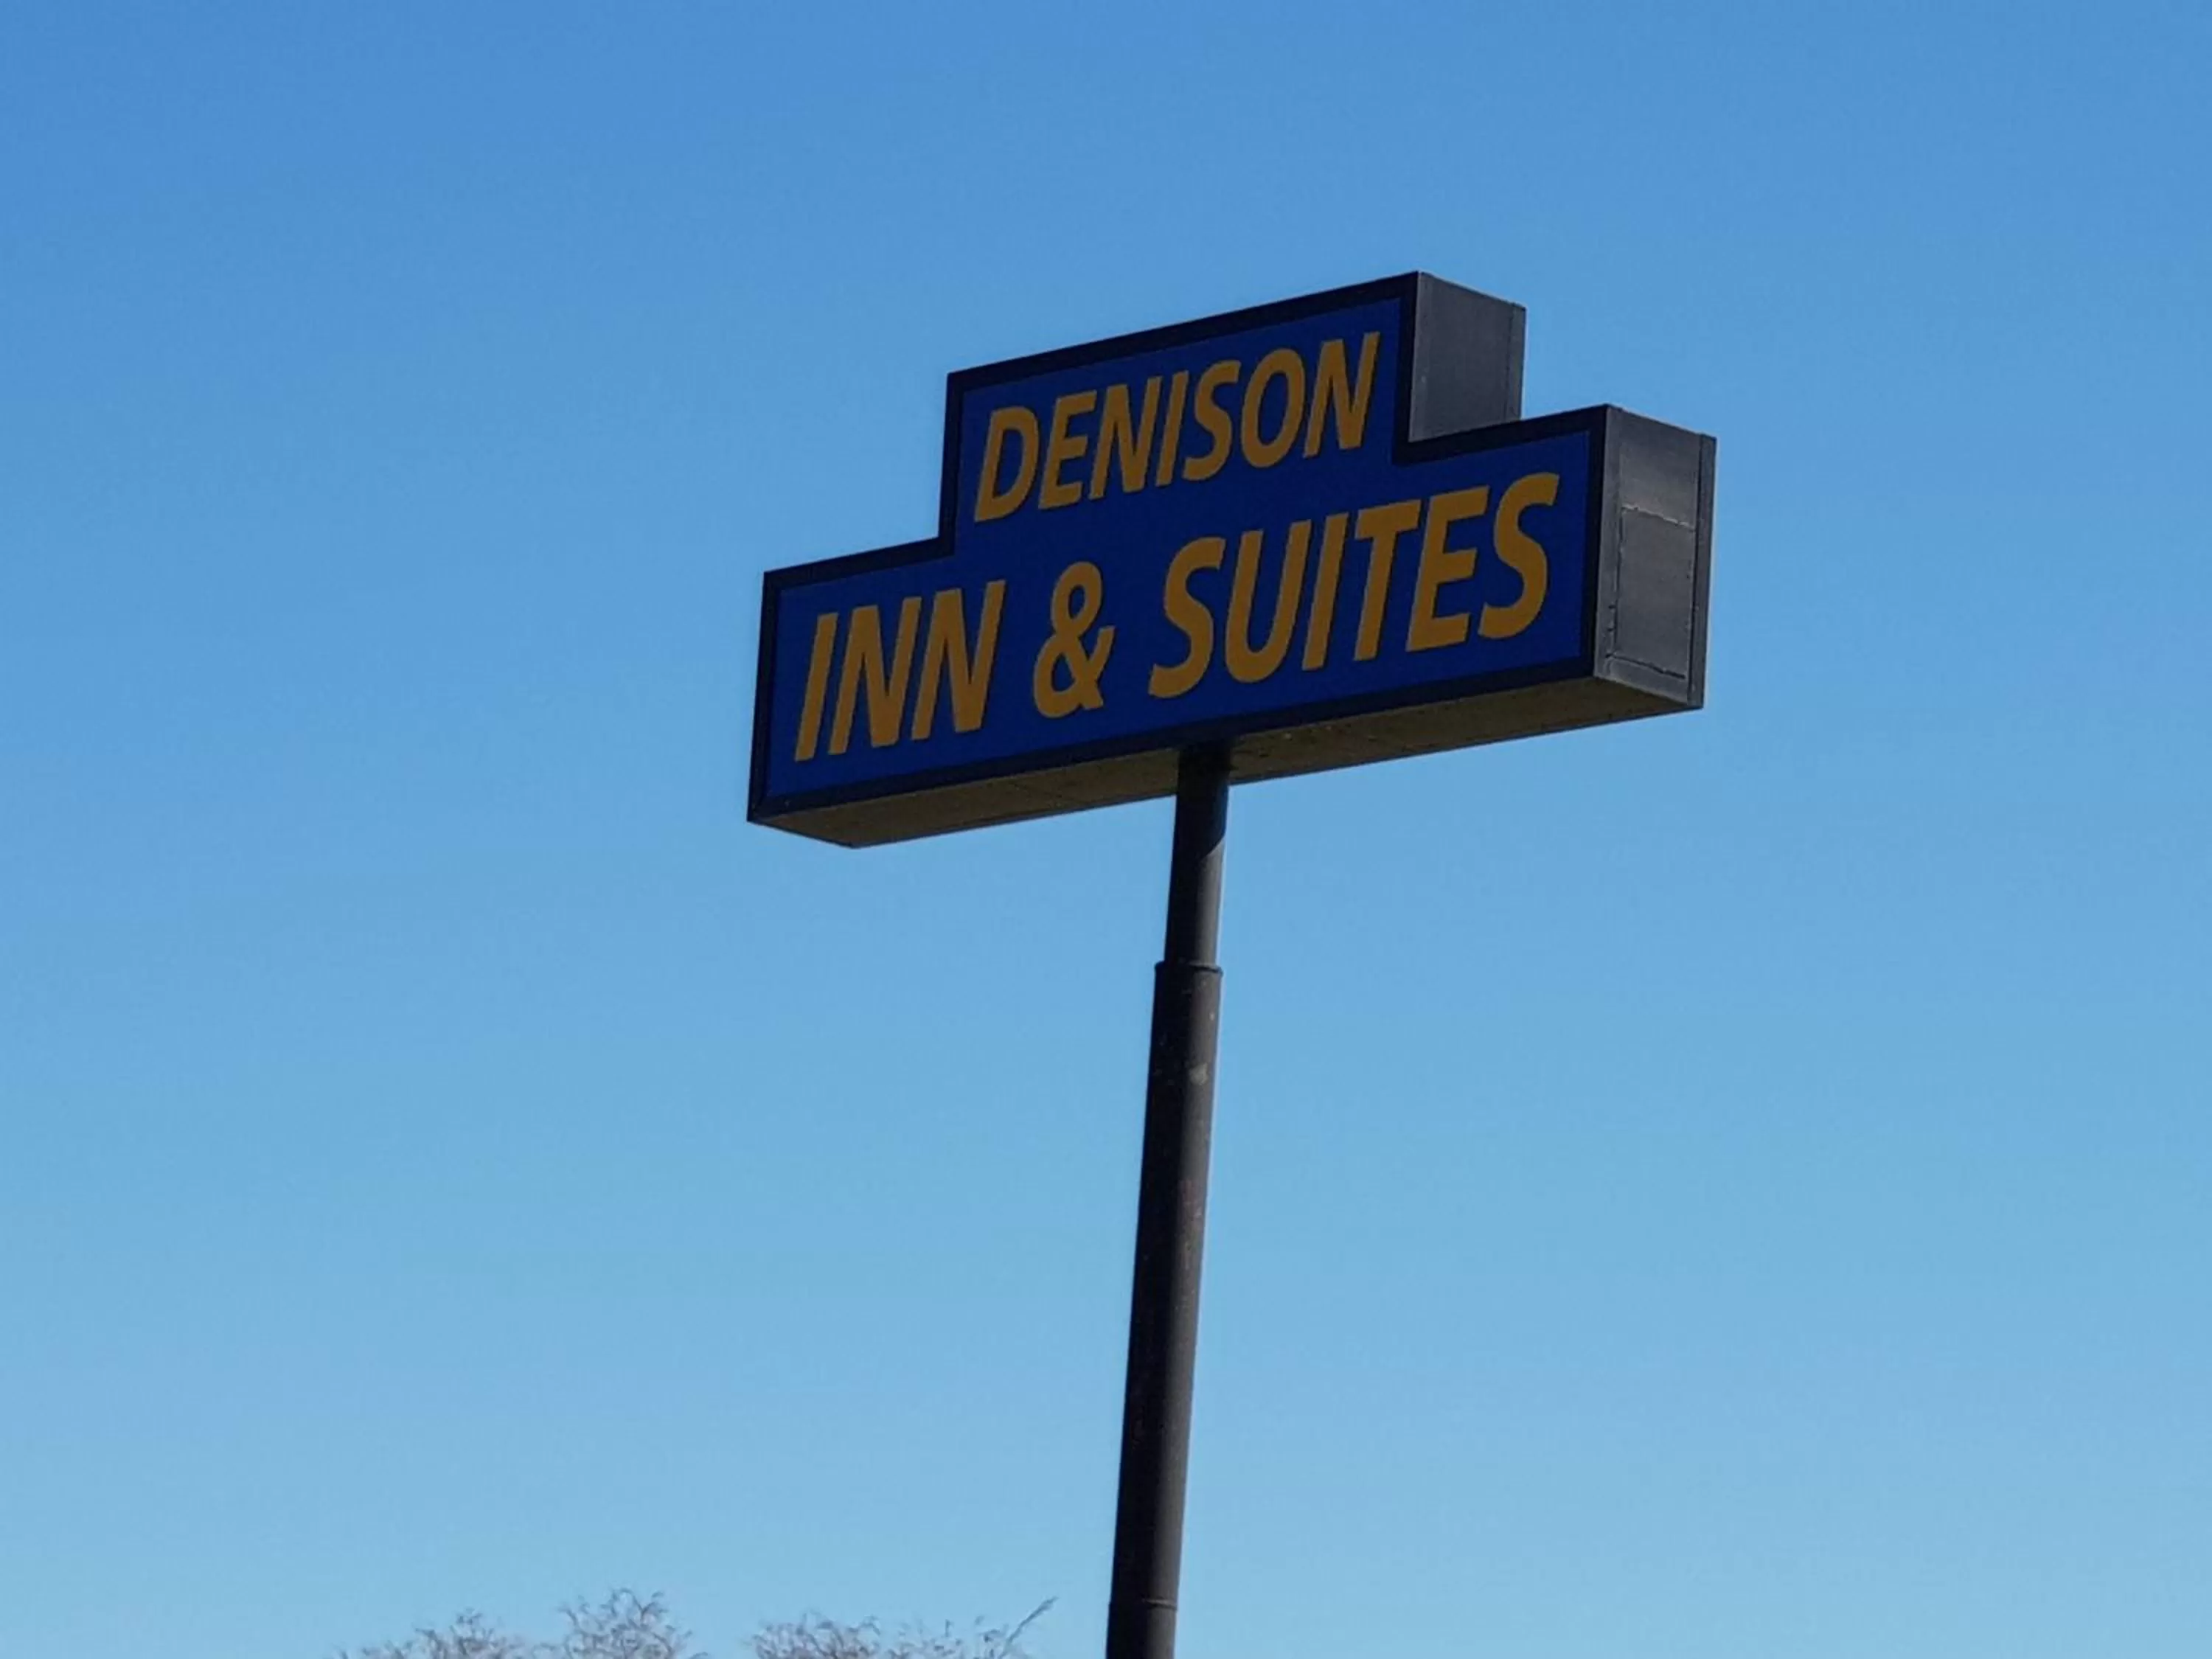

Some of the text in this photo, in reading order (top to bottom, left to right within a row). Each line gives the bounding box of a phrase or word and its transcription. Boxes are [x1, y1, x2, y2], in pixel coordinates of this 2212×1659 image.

[974, 331, 1380, 522] DENISON
[794, 472, 1560, 762] INN & SUITES
